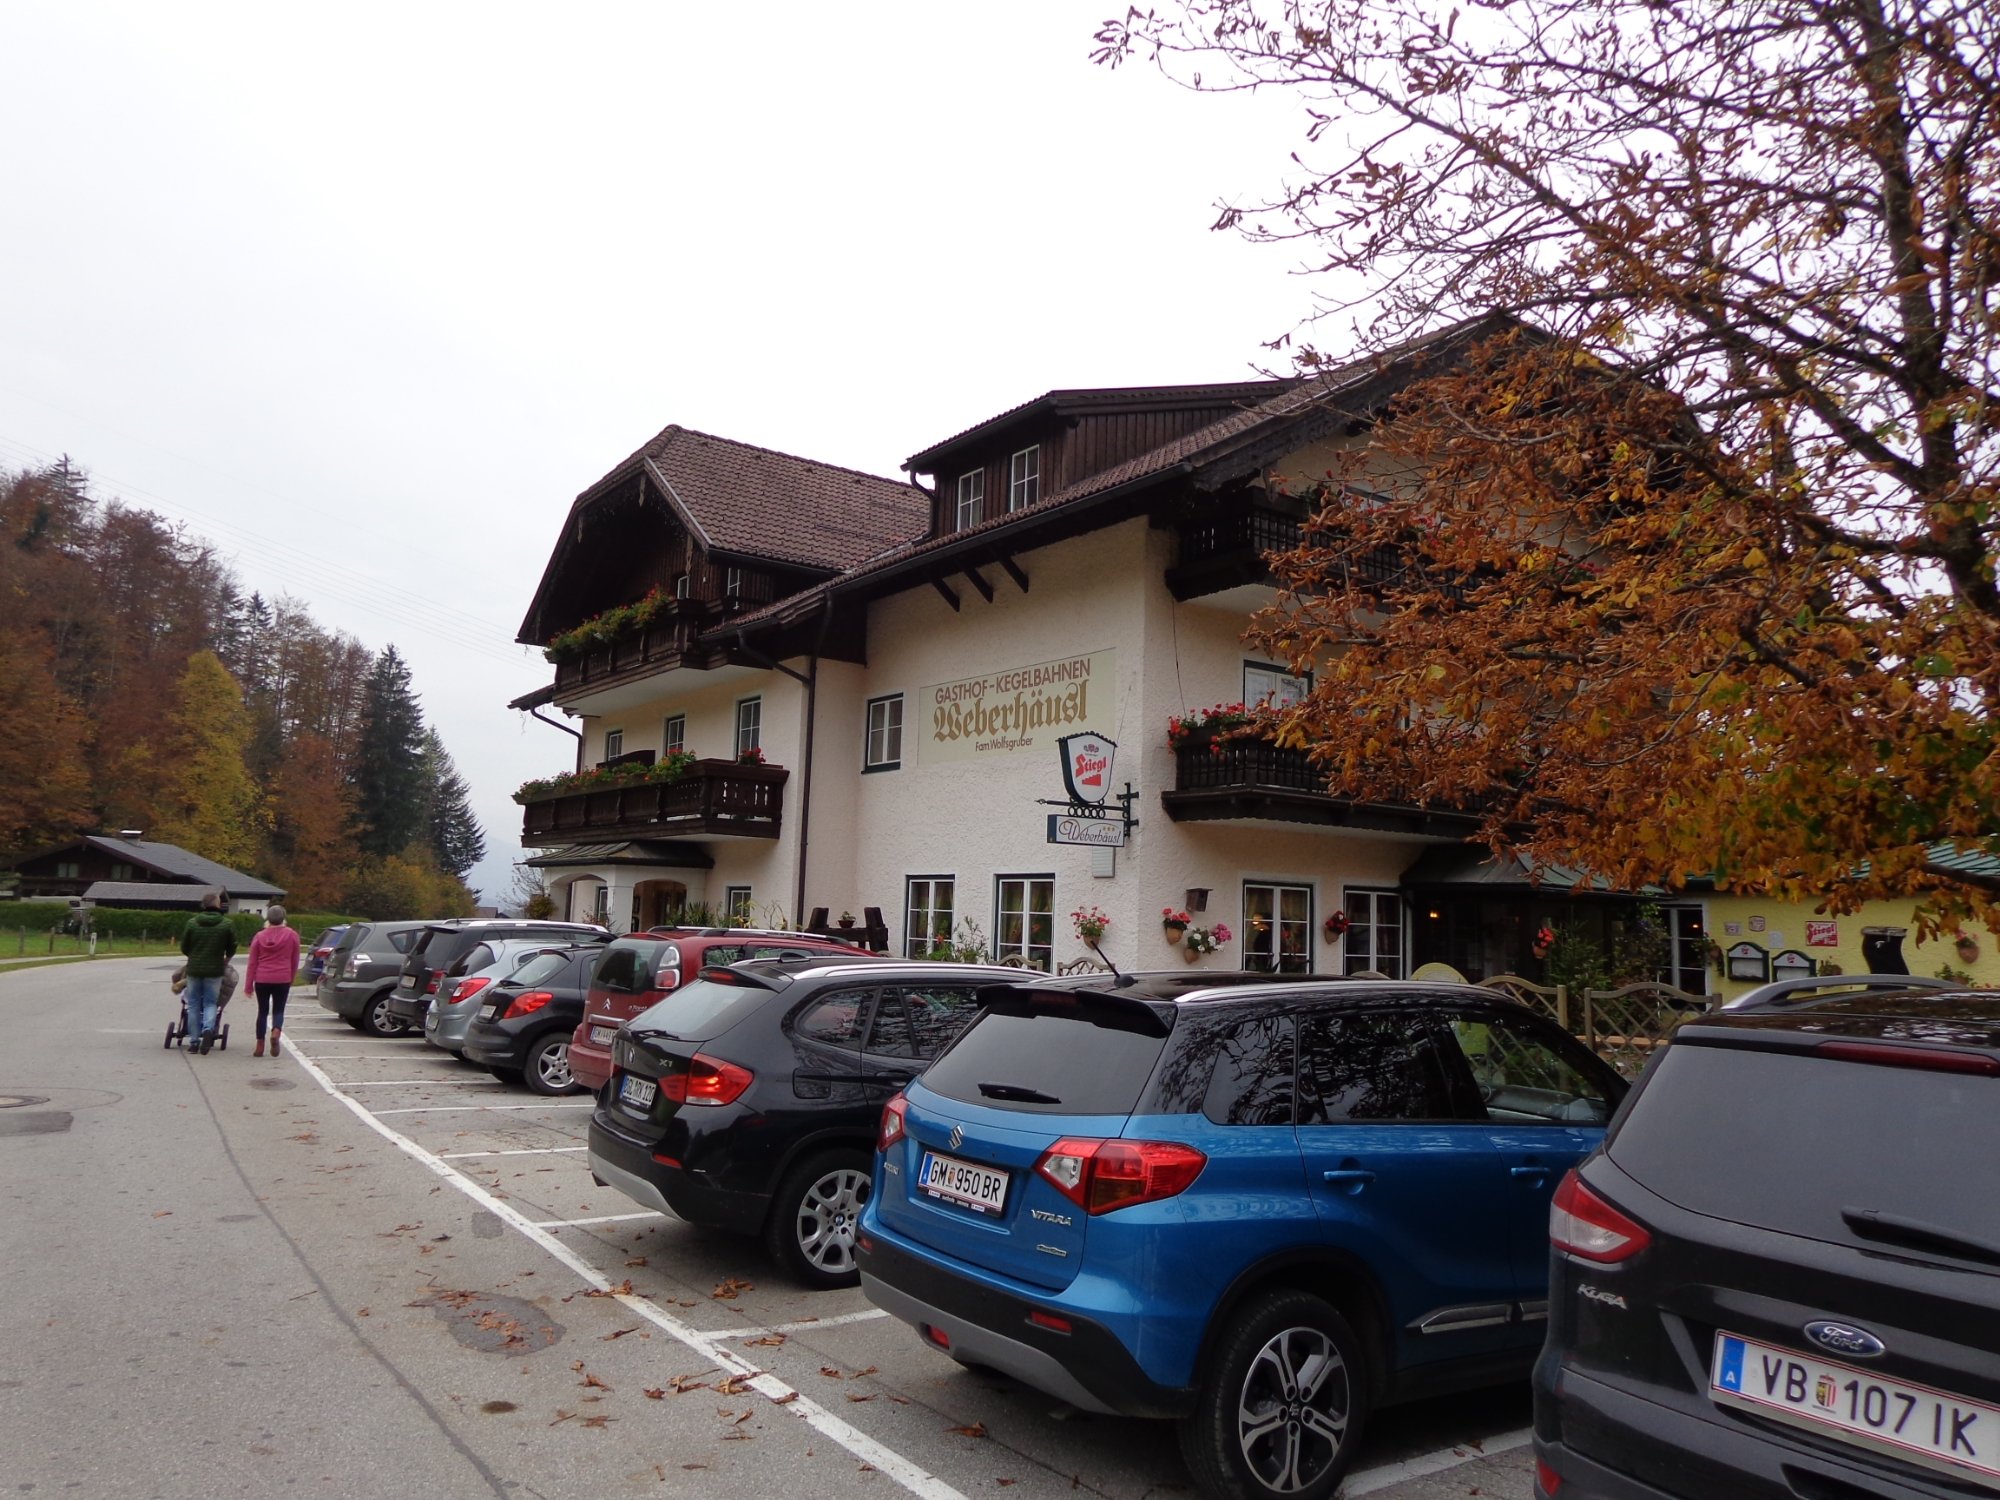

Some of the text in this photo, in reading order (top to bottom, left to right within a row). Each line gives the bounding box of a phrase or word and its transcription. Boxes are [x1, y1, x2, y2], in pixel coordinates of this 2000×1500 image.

[933, 679, 1089, 742] Weberhäusl
[990, 736, 1033, 751] Wolfsgruber
[1075, 753, 1107, 778] Stiegl
[659, 1058, 673, 1068] X1
[930, 1160, 949, 1186] GM
[955, 1167, 981, 1196] 950
[981, 1174, 1001, 1203] BR
[1030, 1209, 1072, 1226] VITARA
[1819, 1326, 1864, 1351] Ford
[1725, 1354, 1978, 1456] A VB 107 IK
